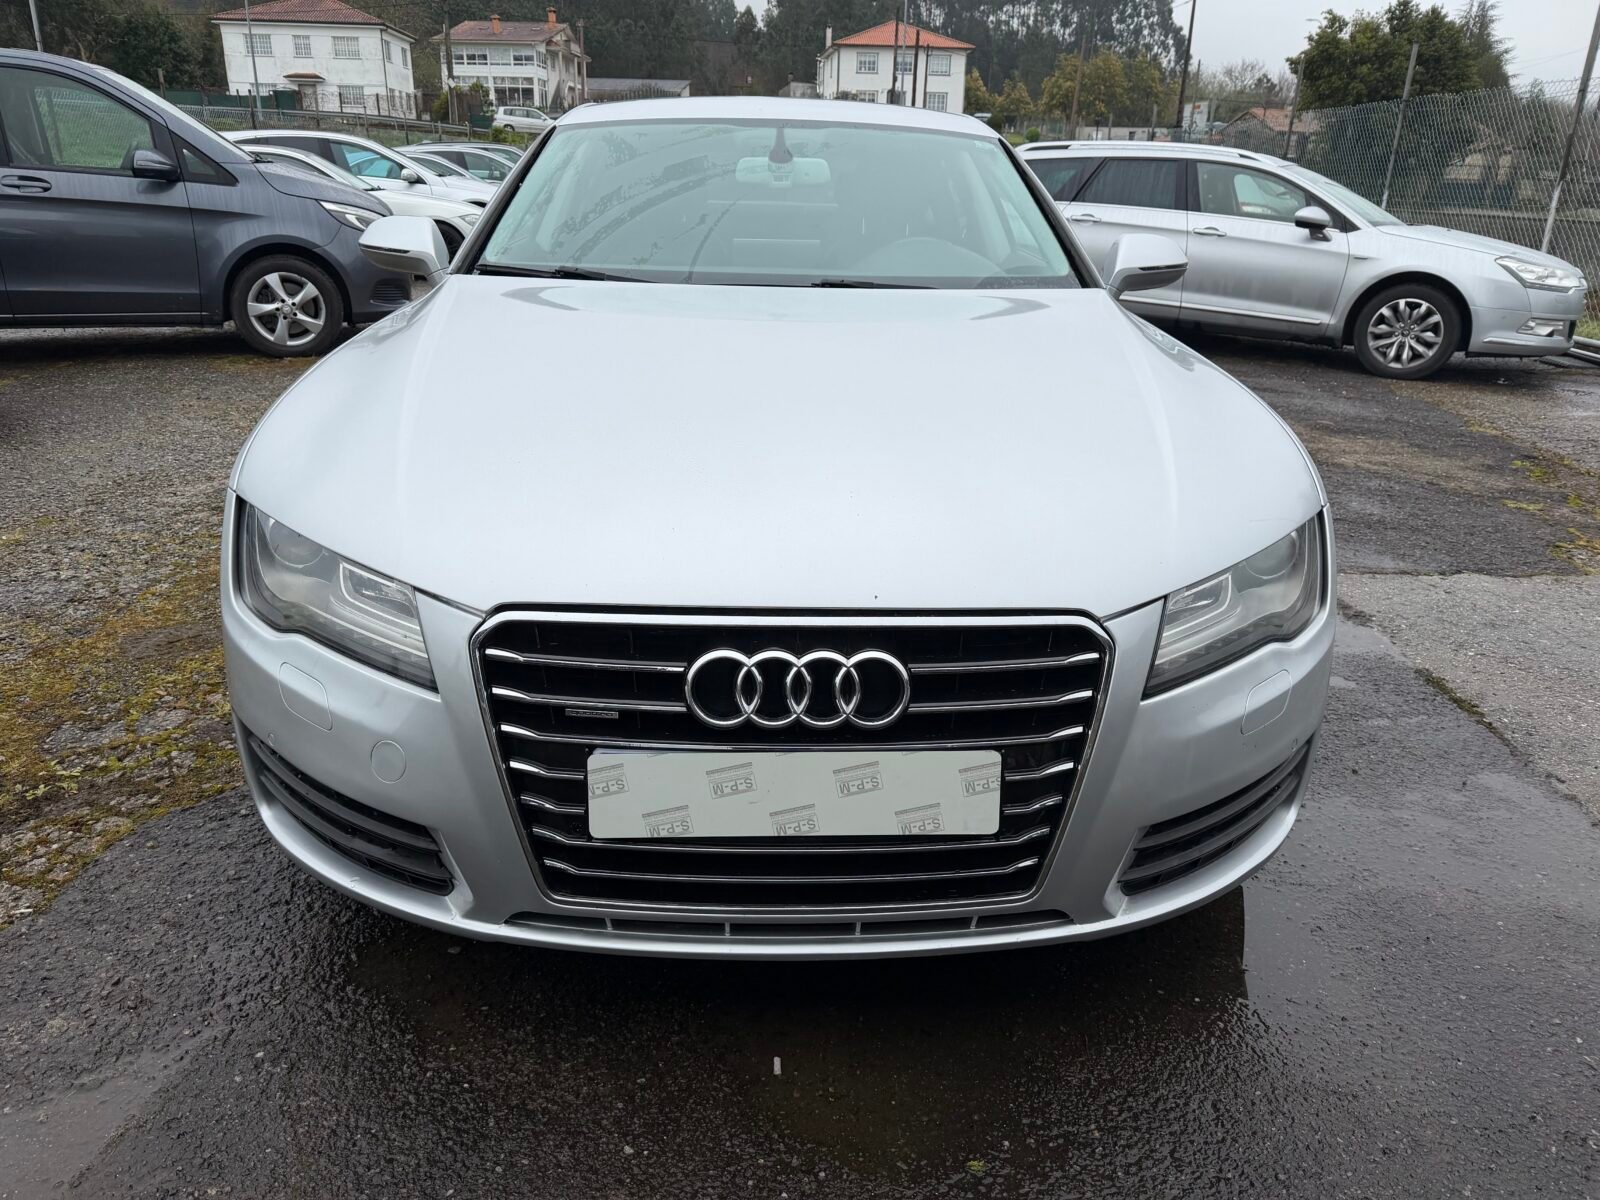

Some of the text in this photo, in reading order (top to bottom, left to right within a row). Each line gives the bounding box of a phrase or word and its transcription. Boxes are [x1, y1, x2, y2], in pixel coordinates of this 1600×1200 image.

[712, 777, 753, 795] S-P-M
[839, 777, 880, 794] S-P-M
[649, 821, 690, 837] S-P-M
[776, 820, 817, 836] S-P-M
[901, 819, 941, 835] S-P-M
